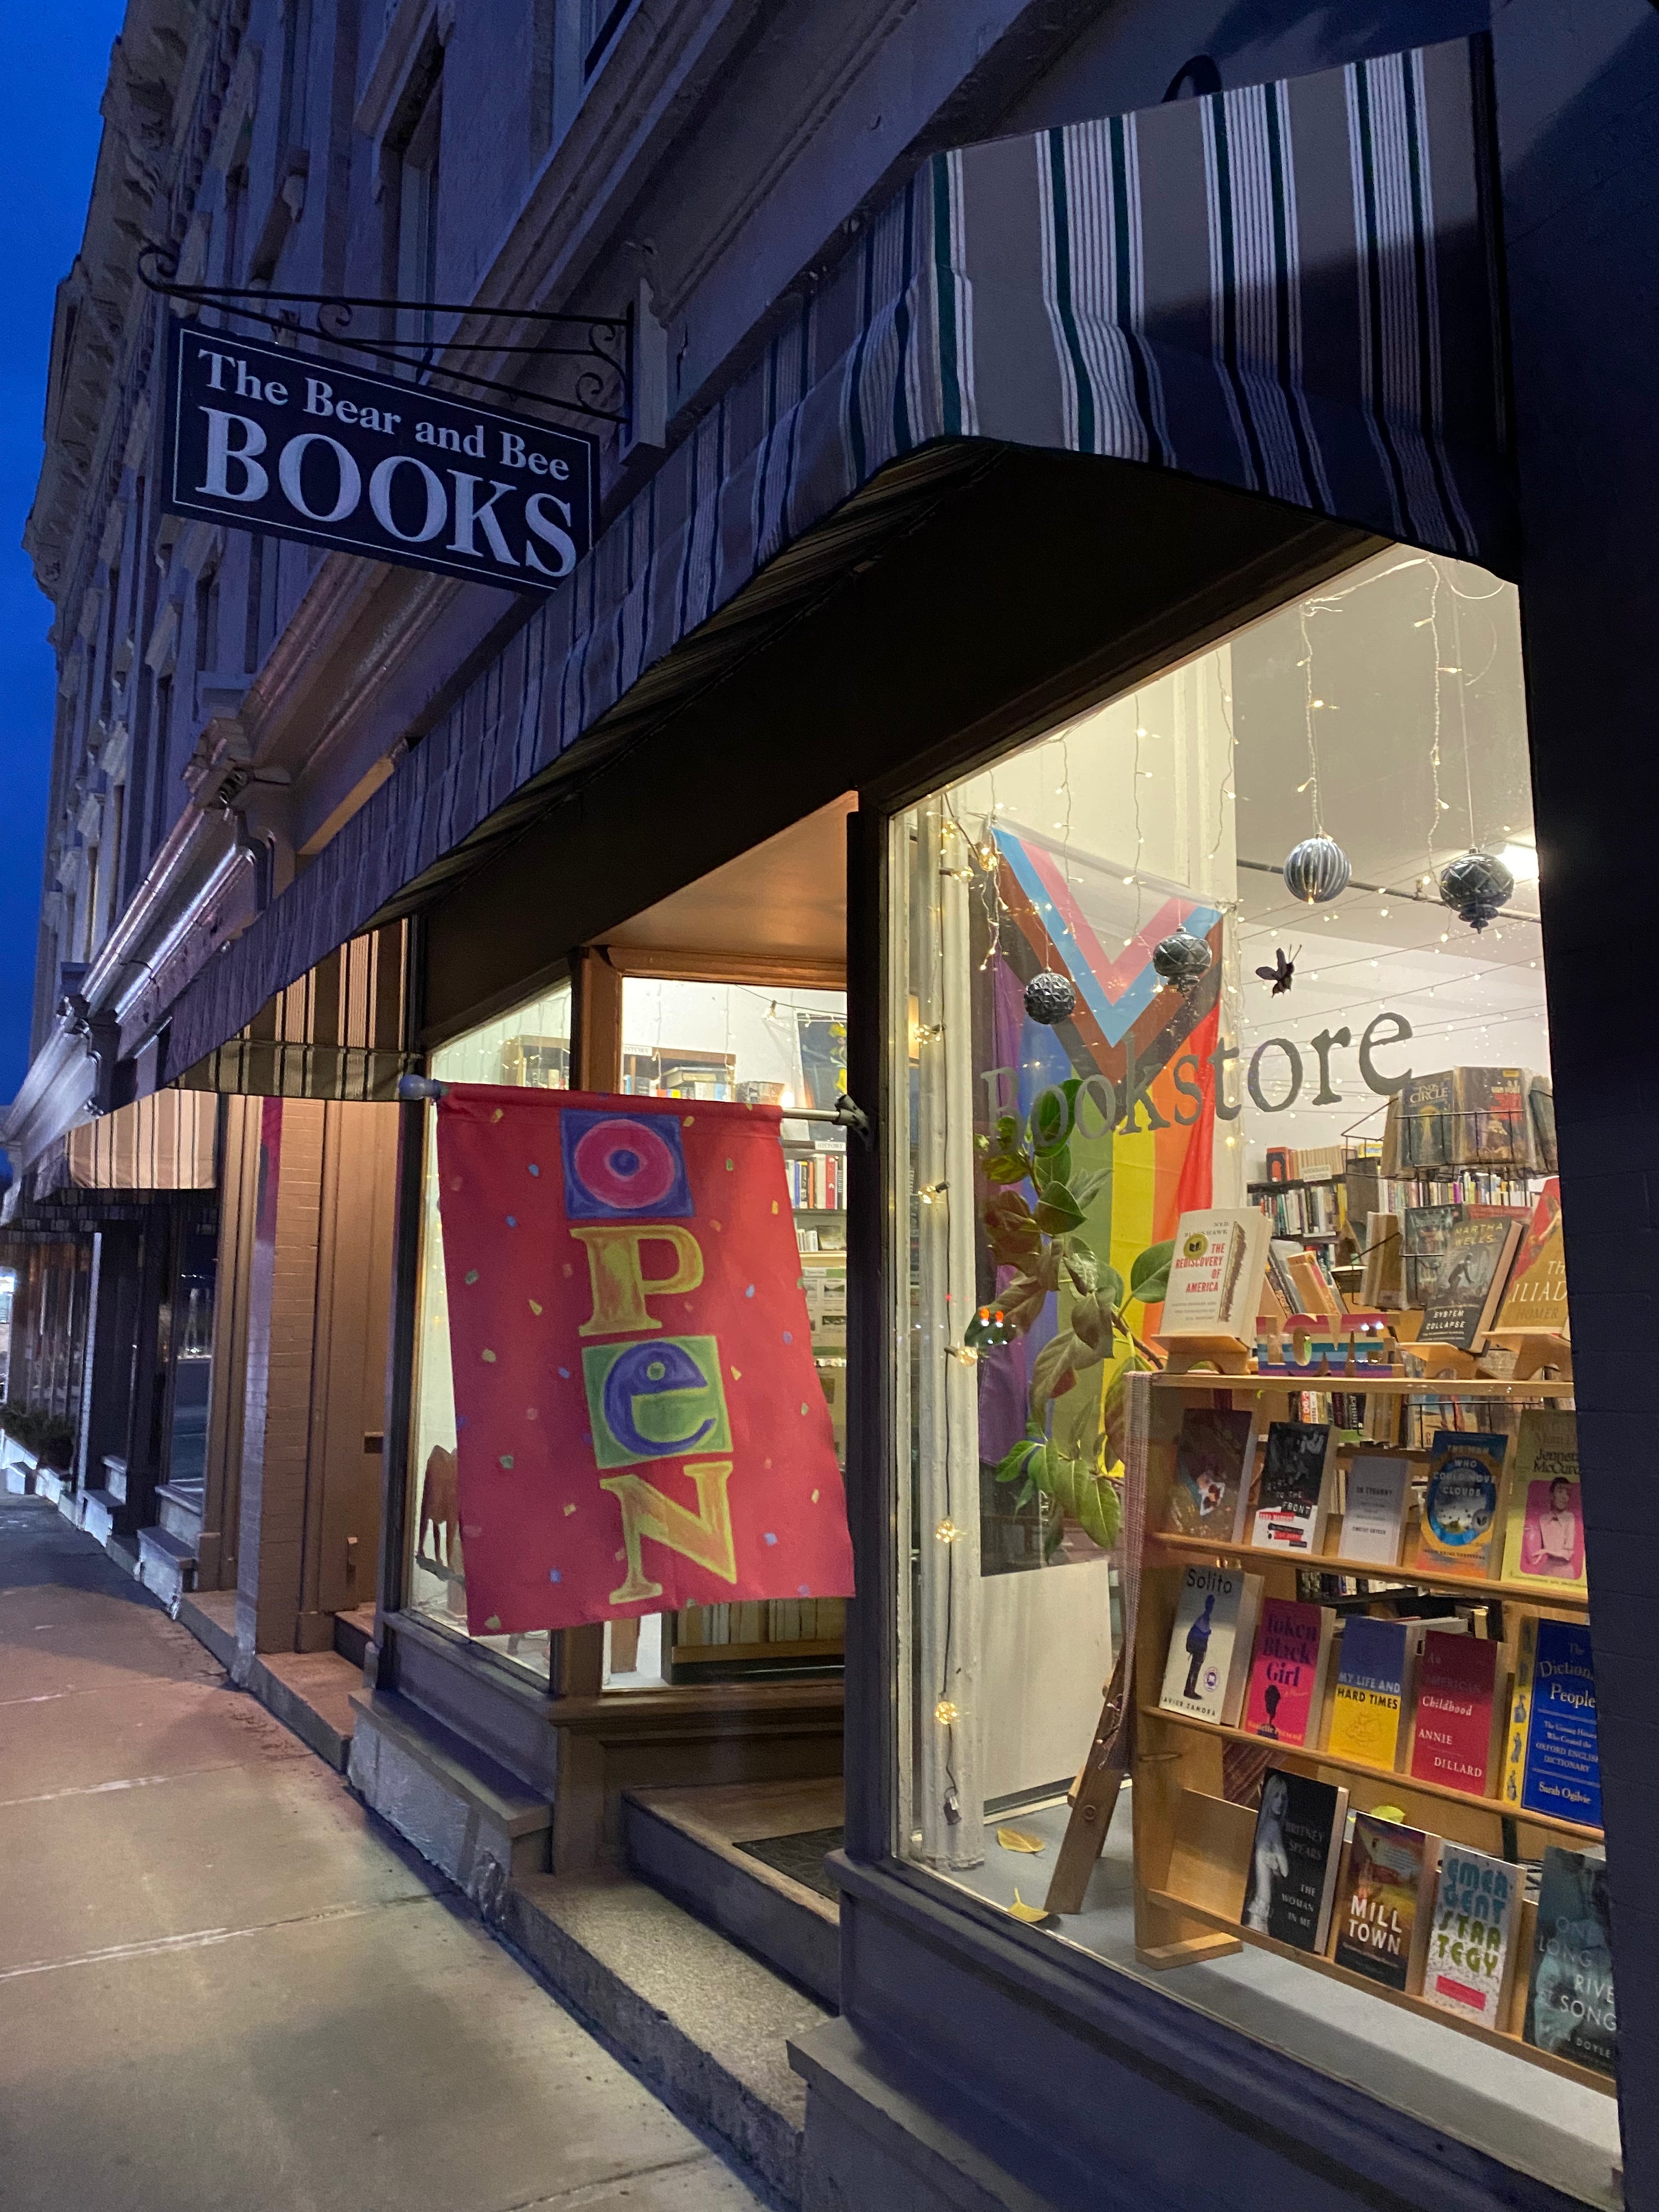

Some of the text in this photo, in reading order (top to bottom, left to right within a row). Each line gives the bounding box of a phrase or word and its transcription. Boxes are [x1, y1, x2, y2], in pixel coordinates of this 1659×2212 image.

[198, 349, 569, 481] The Bear and Bee
[195, 406, 576, 577] BOOKS
[980, 1012, 1413, 1152] Bookstore
[1211, 1243, 1226, 1254] THE
[1455, 1234, 1494, 1246] WELLS
[1175, 1256, 1223, 1269] REDISCOVERY
[1548, 1261, 1566, 1274] TH
[1211, 1268, 1222, 1279] OF
[1186, 1282, 1218, 1293] AMERICA
[1509, 1280, 1567, 1303] ILIAD
[1426, 1321, 1466, 1330] COLLAPSE
[1454, 1459, 1477, 1468] WHO
[1442, 1486, 1481, 1497] CLOUDS
[1282, 1501, 1311, 1515] FRONT
[1187, 1568, 1233, 1594] Solito
[1266, 1661, 1301, 1687] Girl
[1539, 1660, 1594, 1680] Diction
[1338, 1673, 1401, 1694] MY LIFE AND
[1163, 1696, 1216, 1716] AVIER ZAMORA
[1337, 1688, 1398, 1710] HARD TIMES
[1423, 1696, 1473, 1716] Childhood
[1550, 1683, 1596, 1709] People
[1419, 1729, 1453, 1745] ANNIE
[1536, 1742, 1566, 1756] OXFORD
[1434, 1757, 1482, 1778] DILLARD
[1544, 1756, 1590, 1772] DICTIONARY
[1538, 1782, 1561, 1797] Sarah
[1301, 1883, 1316, 1897] THE
[1282, 1893, 1314, 1912] WOMAN
[1300, 1916, 1311, 1928] ME
[1351, 1895, 1402, 1933] MILL
[1348, 1919, 1401, 1956] TOWN
[1539, 1935, 1592, 1967] LONG
[1574, 1974, 1615, 2004] RIVE
[1560, 1995, 1617, 2032] SONG
